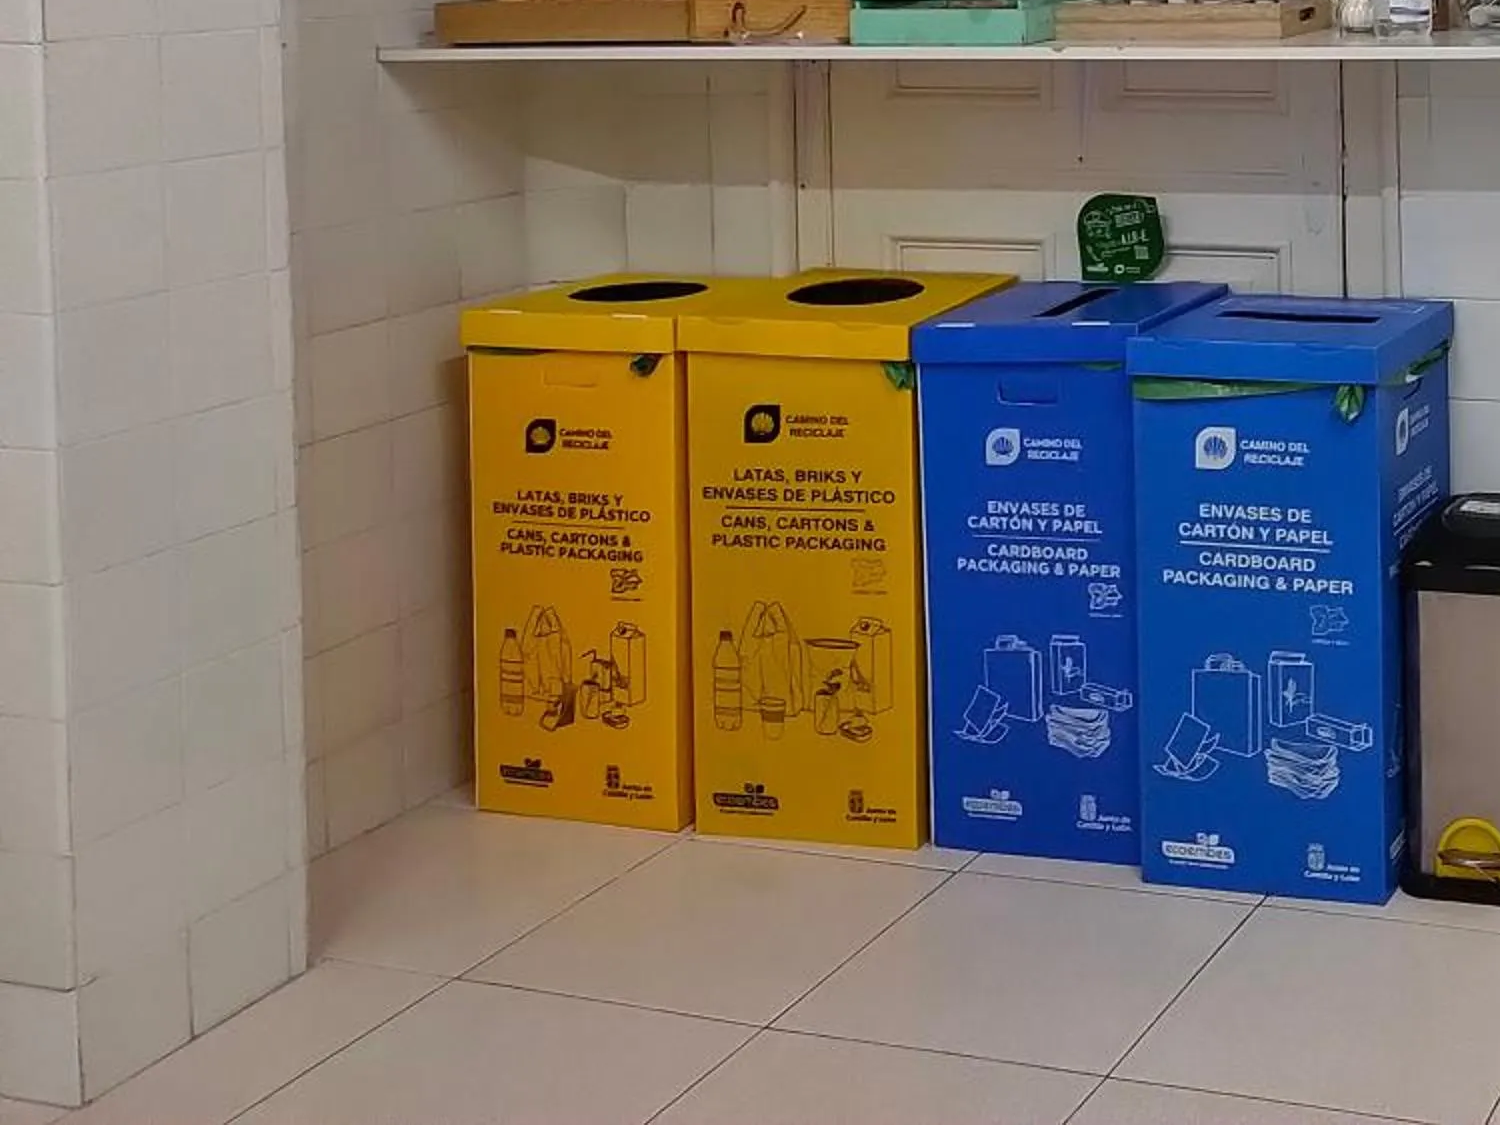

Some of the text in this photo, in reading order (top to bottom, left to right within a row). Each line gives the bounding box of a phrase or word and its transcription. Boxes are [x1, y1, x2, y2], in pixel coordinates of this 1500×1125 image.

[785, 414, 849, 426] CAMINO DEL
[559, 428, 613, 439] CAMINO DEL
[789, 428, 846, 439] RECICLAJE
[561, 439, 609, 450] RECICLAJE
[1023, 437, 1083, 450] CAMINO DEL
[1240, 439, 1311, 454] CAMINO DEL
[1027, 449, 1079, 462] RECICLAJE
[1244, 453, 1305, 467] RECICLAJE
[733, 468, 862, 484] LATAS, BRIKS Y
[517, 490, 624, 507] LATAS, BRIKS Y
[702, 485, 896, 505] ENVASES DE PLÁSTICO
[493, 502, 651, 523] ENVASES DE PLÁSTICO
[987, 500, 1087, 518] ENVASES DE
[1199, 503, 1313, 524] ENVASES DE
[720, 514, 876, 533] CANS, CARTONS &
[967, 513, 1103, 534] CARTÓN Y PAPEL
[507, 527, 631, 548] CANS, CARTONS &
[1178, 520, 1334, 546] CARTÓN Y PAPEL
[712, 533, 887, 552] PLASTIC PACKAGING
[500, 542, 643, 563] PLASTIC PACKAGING
[987, 543, 1089, 561] CARDBOARD
[957, 557, 1121, 578] PACKAGING & PAPER
[1199, 551, 1316, 573] CARDBOARD
[1163, 570, 1354, 596] PACKAGING & PAPER
